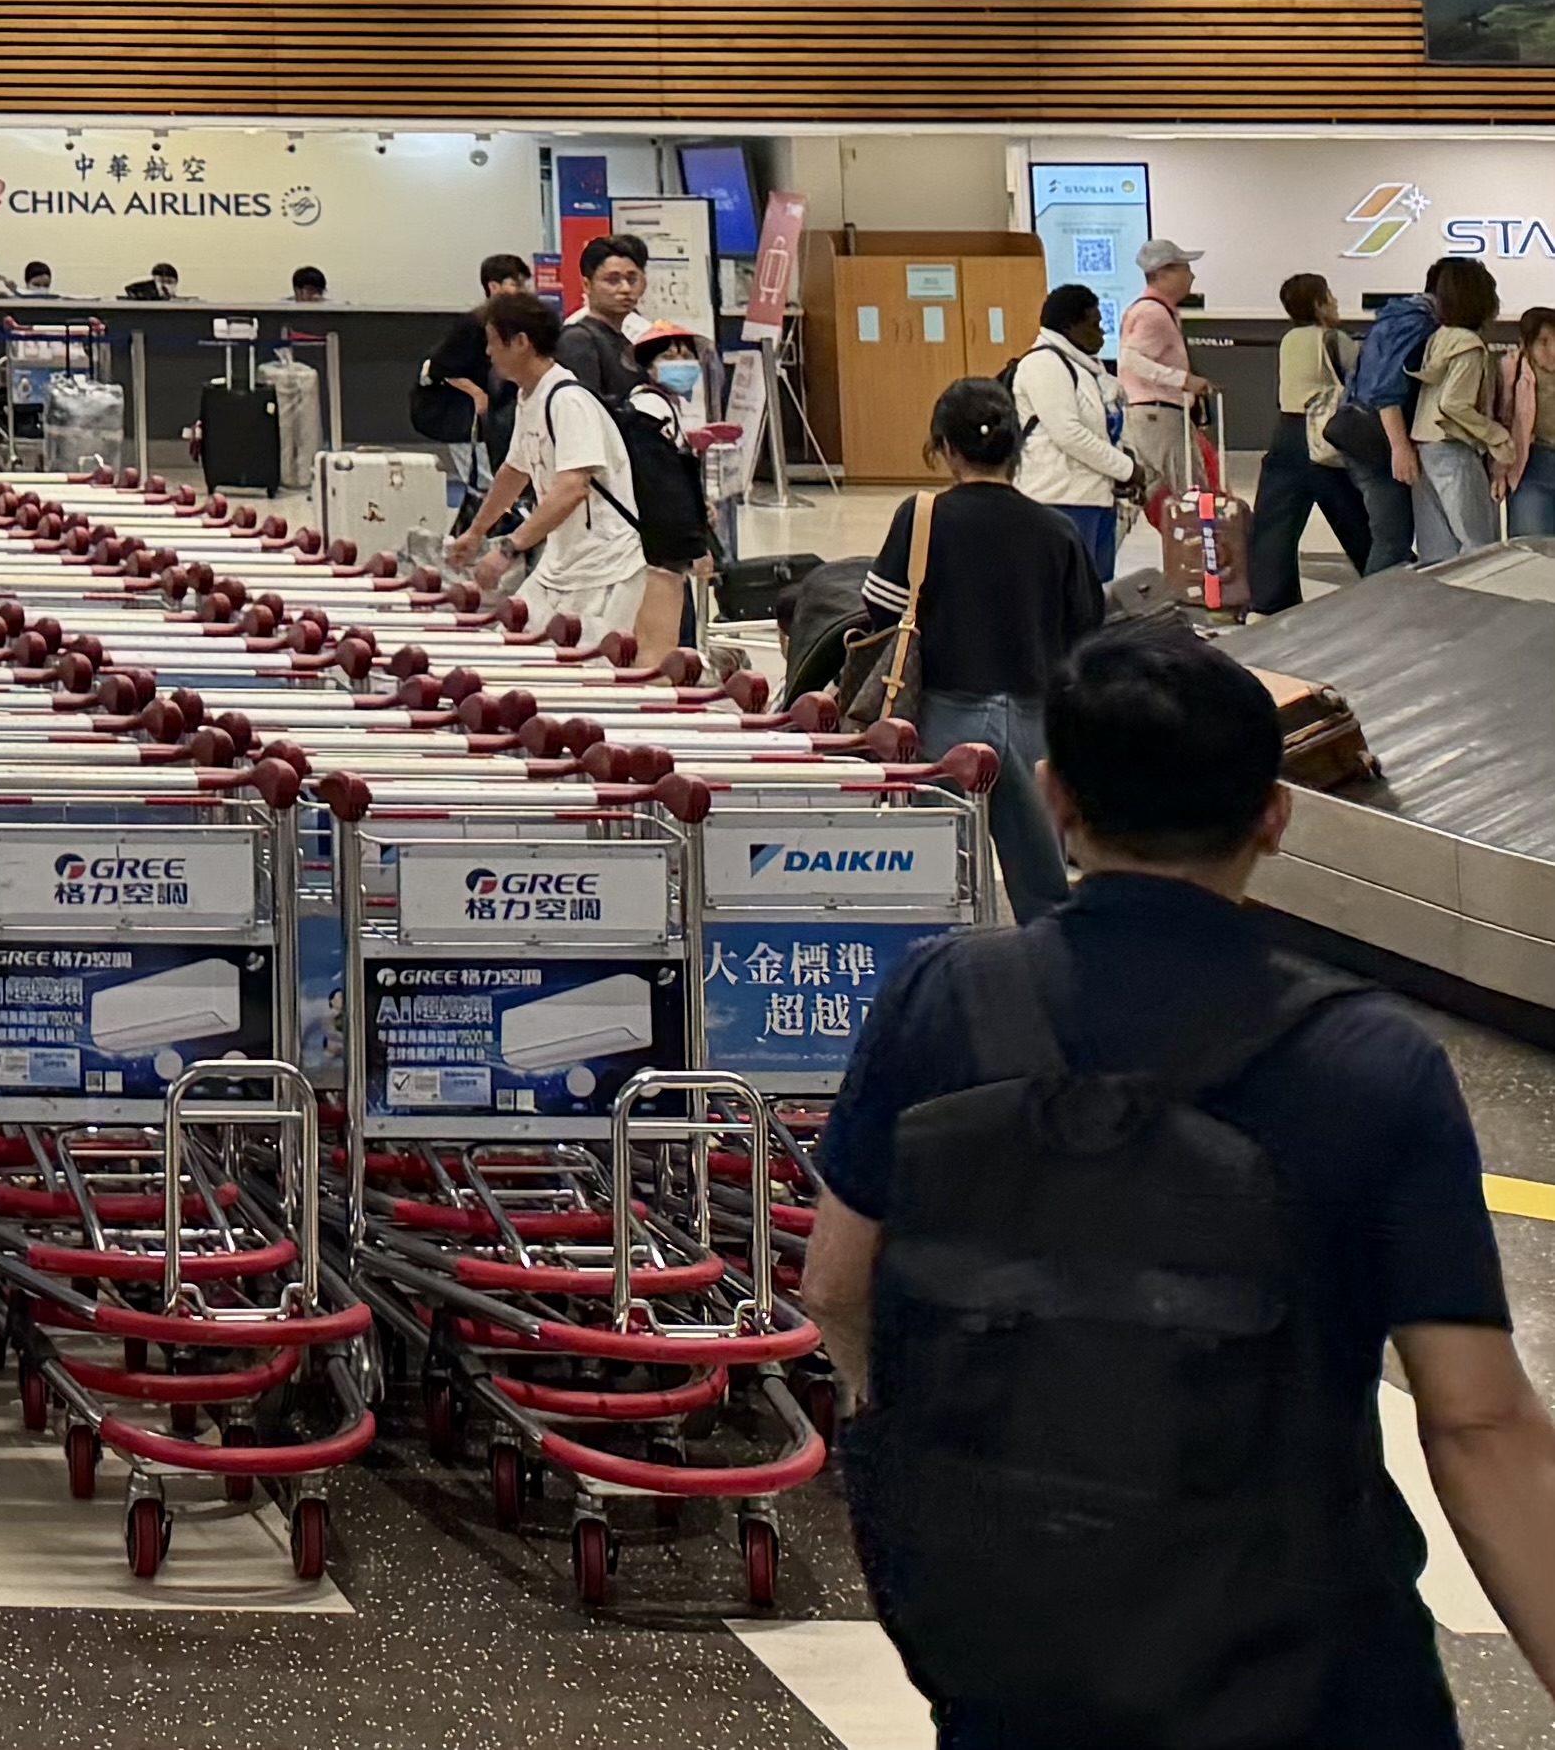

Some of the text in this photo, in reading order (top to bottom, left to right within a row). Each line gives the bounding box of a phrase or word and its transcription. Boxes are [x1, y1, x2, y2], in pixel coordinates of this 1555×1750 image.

[74, 153, 208, 182] 中華航空
[9, 191, 271, 216] CHINA AIRLINES
[89, 857, 186, 880] GREE
[783, 850, 914, 872] DAIKIN
[54, 883, 188, 906] 格力空調
[501, 873, 598, 895] GREE
[465, 898, 601, 921] 格力空調
[704, 941, 876, 986] 大金標準
[400, 969, 458, 985] GREE
